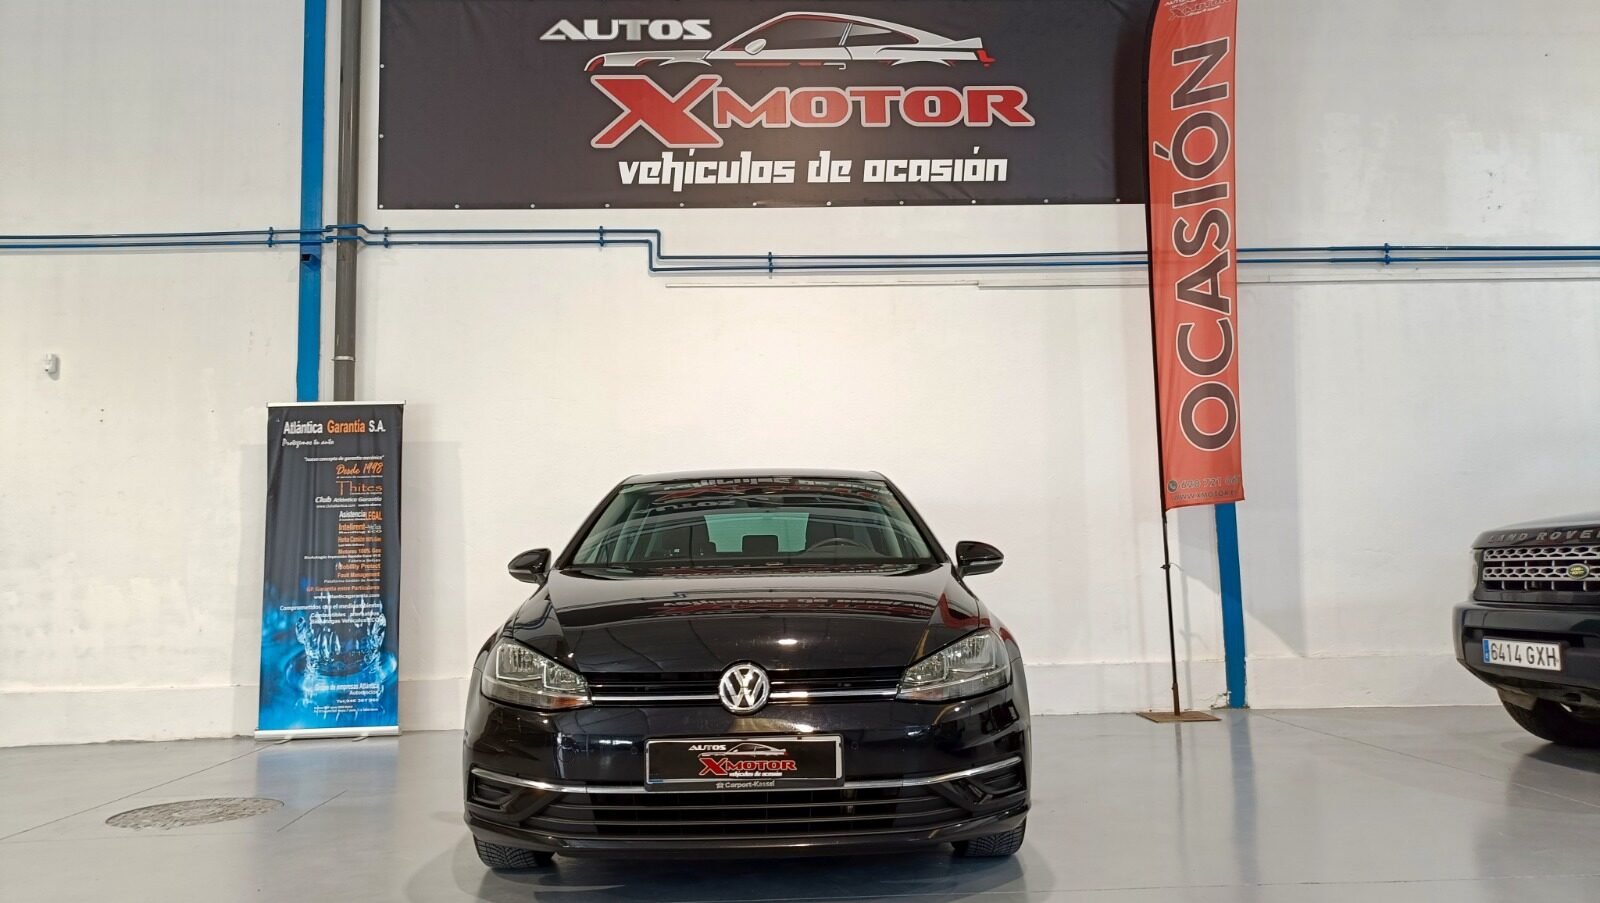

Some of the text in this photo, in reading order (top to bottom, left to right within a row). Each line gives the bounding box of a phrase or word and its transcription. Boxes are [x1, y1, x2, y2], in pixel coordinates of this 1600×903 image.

[540, 18, 712, 41] AUTOS
[590, 74, 1036, 149] XMOTOR
[618, 147, 1008, 193] vehículos de ocasión
[1153, 36, 1239, 452] OCASIÓN
[283, 420, 323, 435] Atlántica
[368, 419, 386, 433] S.A.
[336, 462, 383, 475] Desde 1998
[315, 495, 332, 504] Club
[1488, 532, 1528, 542] LAND
[1491, 643, 1557, 666] 6414 GXH
[698, 758, 797, 776] XMOTOR
